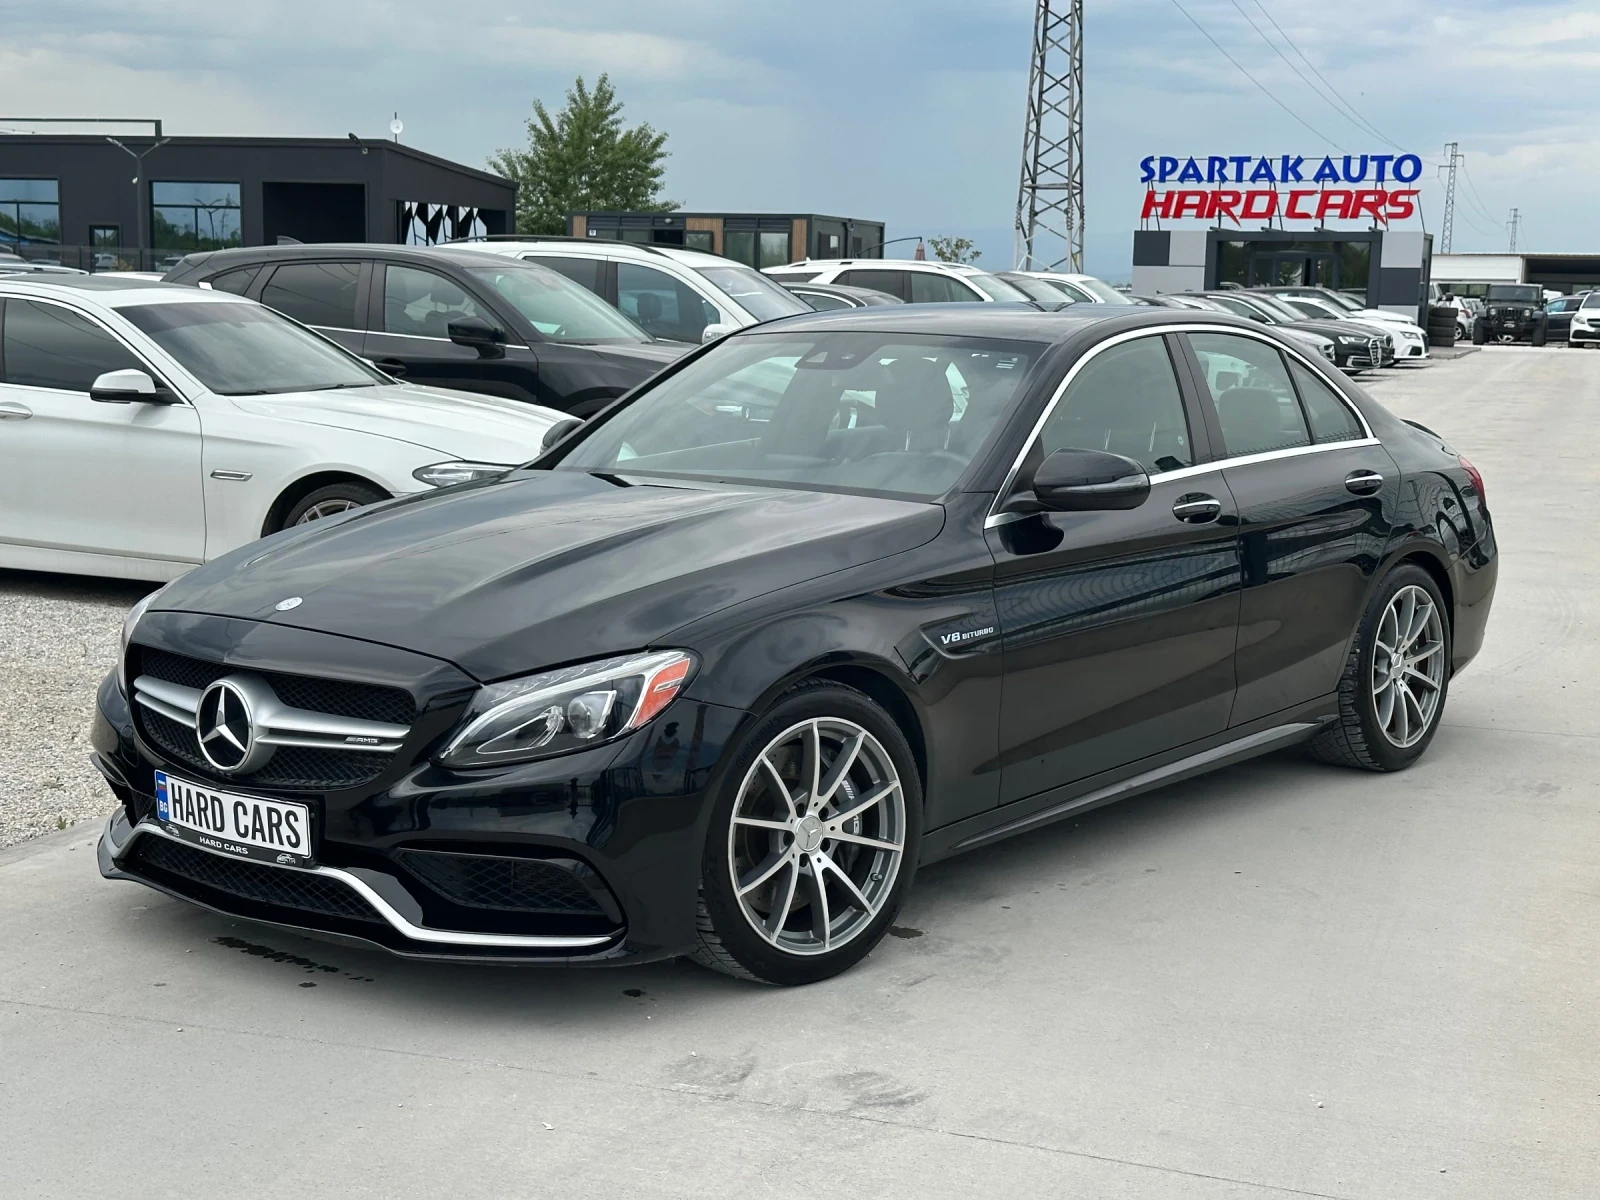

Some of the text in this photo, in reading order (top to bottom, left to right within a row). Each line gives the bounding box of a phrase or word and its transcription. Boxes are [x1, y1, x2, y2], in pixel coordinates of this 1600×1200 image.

[1140, 153, 1423, 184] SPARTAK AUTO
[1140, 189, 1421, 227] HARD CARS
[940, 626, 994, 645] V8 BITURBO
[159, 800, 168, 813] BG
[170, 782, 301, 849] HARD CARS
[199, 836, 249, 855] HARD CARS
